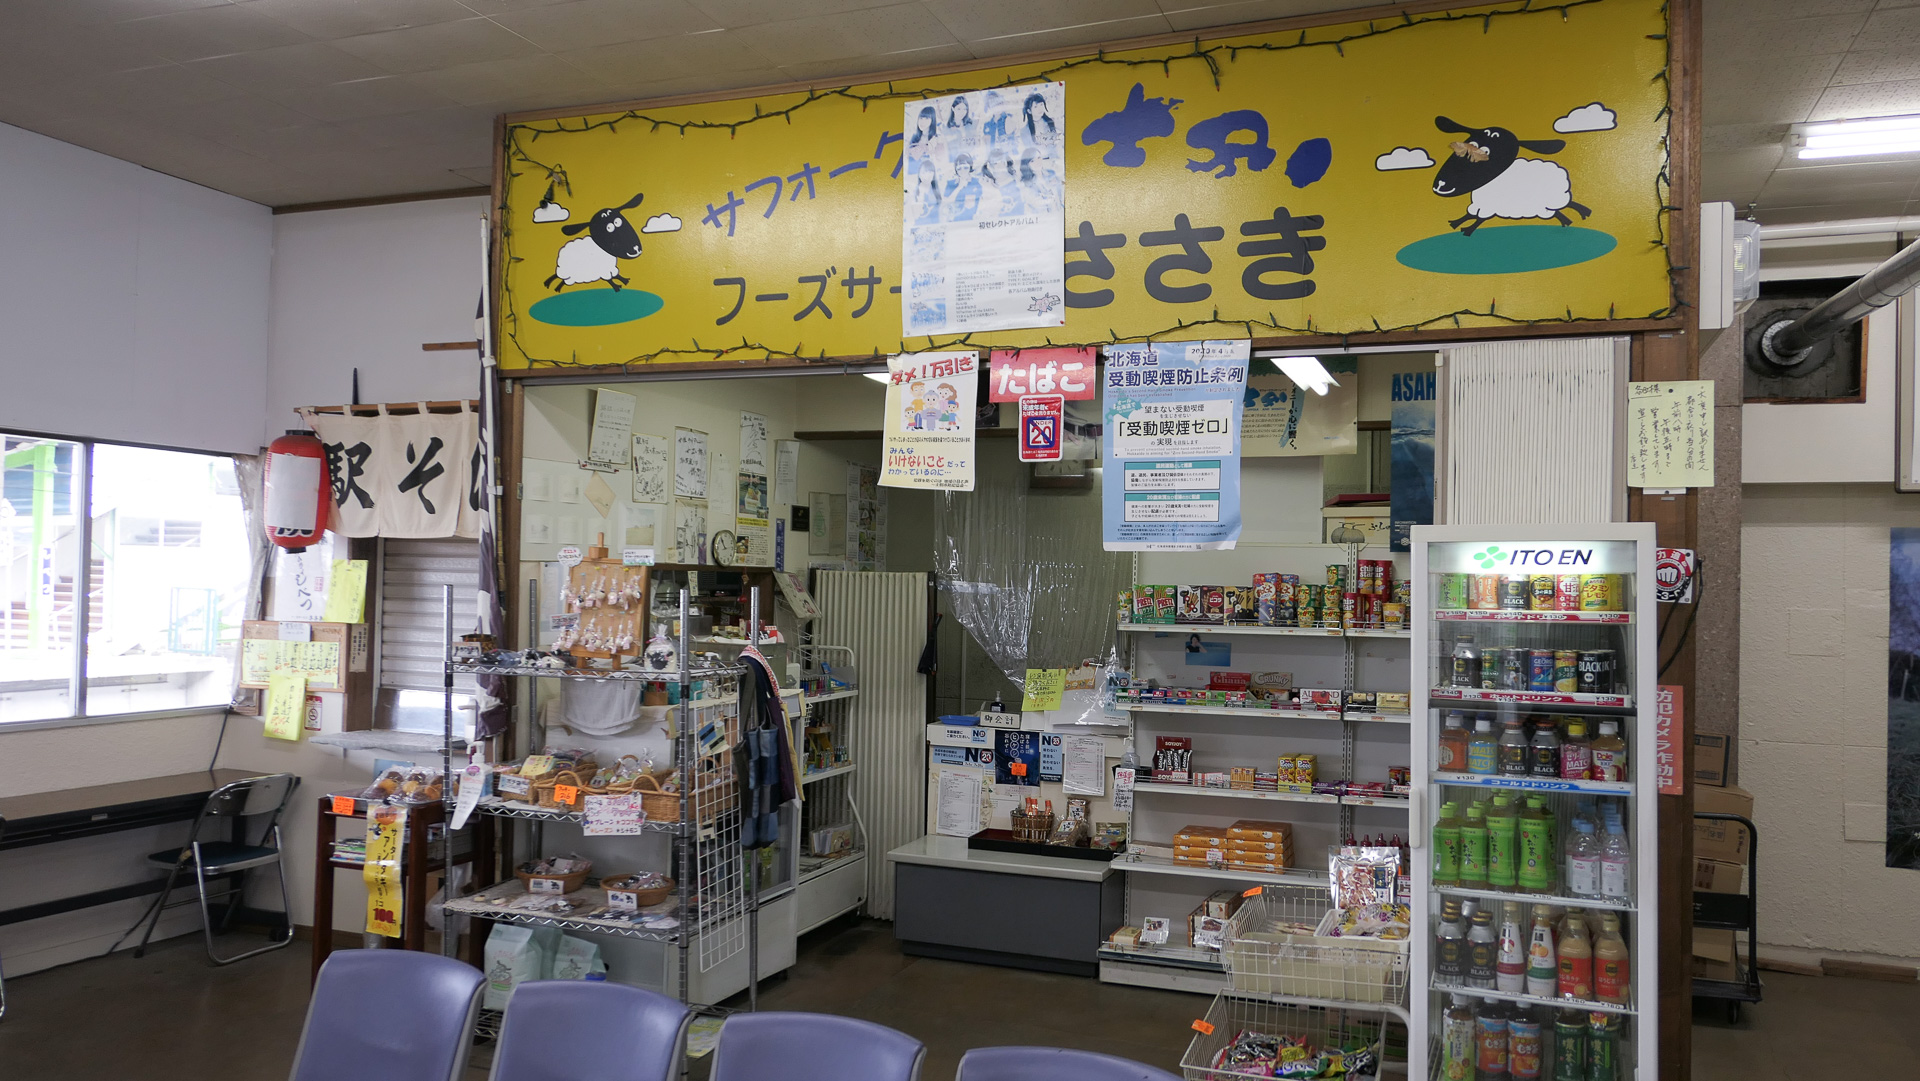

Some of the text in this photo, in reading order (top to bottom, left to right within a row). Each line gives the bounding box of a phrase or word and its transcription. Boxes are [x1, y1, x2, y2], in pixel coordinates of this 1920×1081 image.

[1108, 350, 1159, 367] 北海道
[891, 357, 973, 385] ダメ！万引き
[1109, 366, 1244, 388] 受動喫煙防止条例
[999, 361, 1086, 395] たばこ
[1119, 418, 1228, 436] 「受動喫煙ゼロ」
[888, 455, 945, 468] いけないこと
[1509, 549, 1593, 566] ITO EN
[1578, 660, 1602, 671] BLACK
[1213, 676, 1246, 685] Ghana
[1254, 675, 1289, 687] CRUNKY
[1597, 752, 1613, 760] Dole
[1491, 780, 1570, 789] コールドドリンク
[1470, 968, 1491, 976] BLACK
